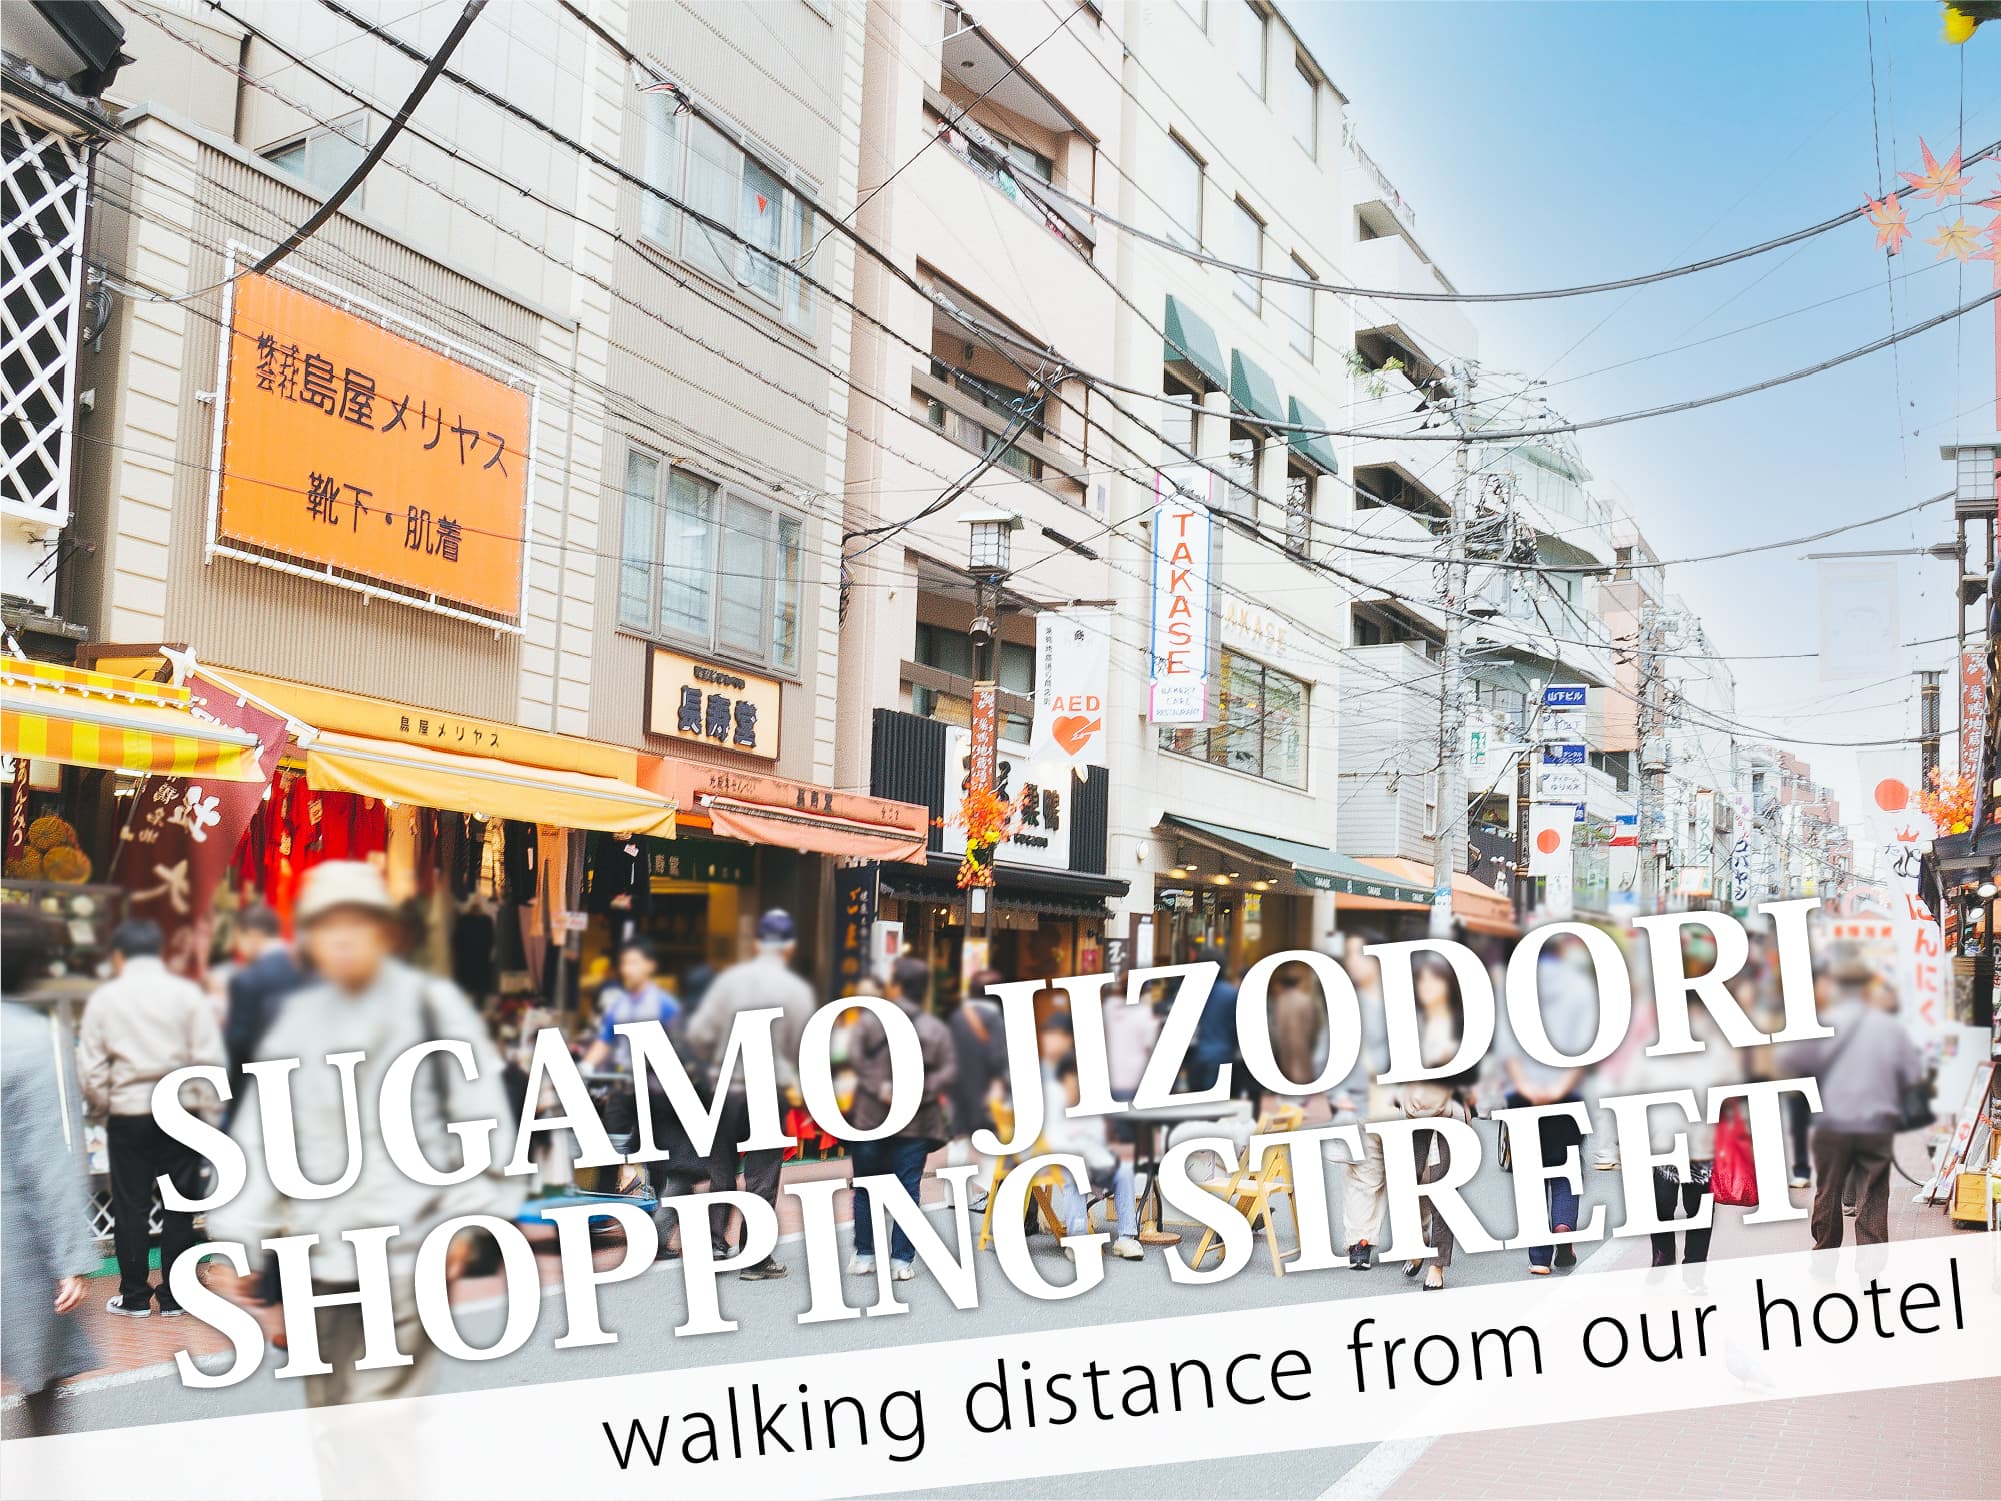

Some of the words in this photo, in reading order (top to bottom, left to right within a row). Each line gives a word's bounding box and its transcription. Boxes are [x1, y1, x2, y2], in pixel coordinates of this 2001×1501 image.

[1166, 511, 1195, 675] TAKASE
[399, 715, 501, 749] 島屋メリヤス
[1052, 695, 1101, 712] AED
[1905, 893, 1940, 1026] にんにく
